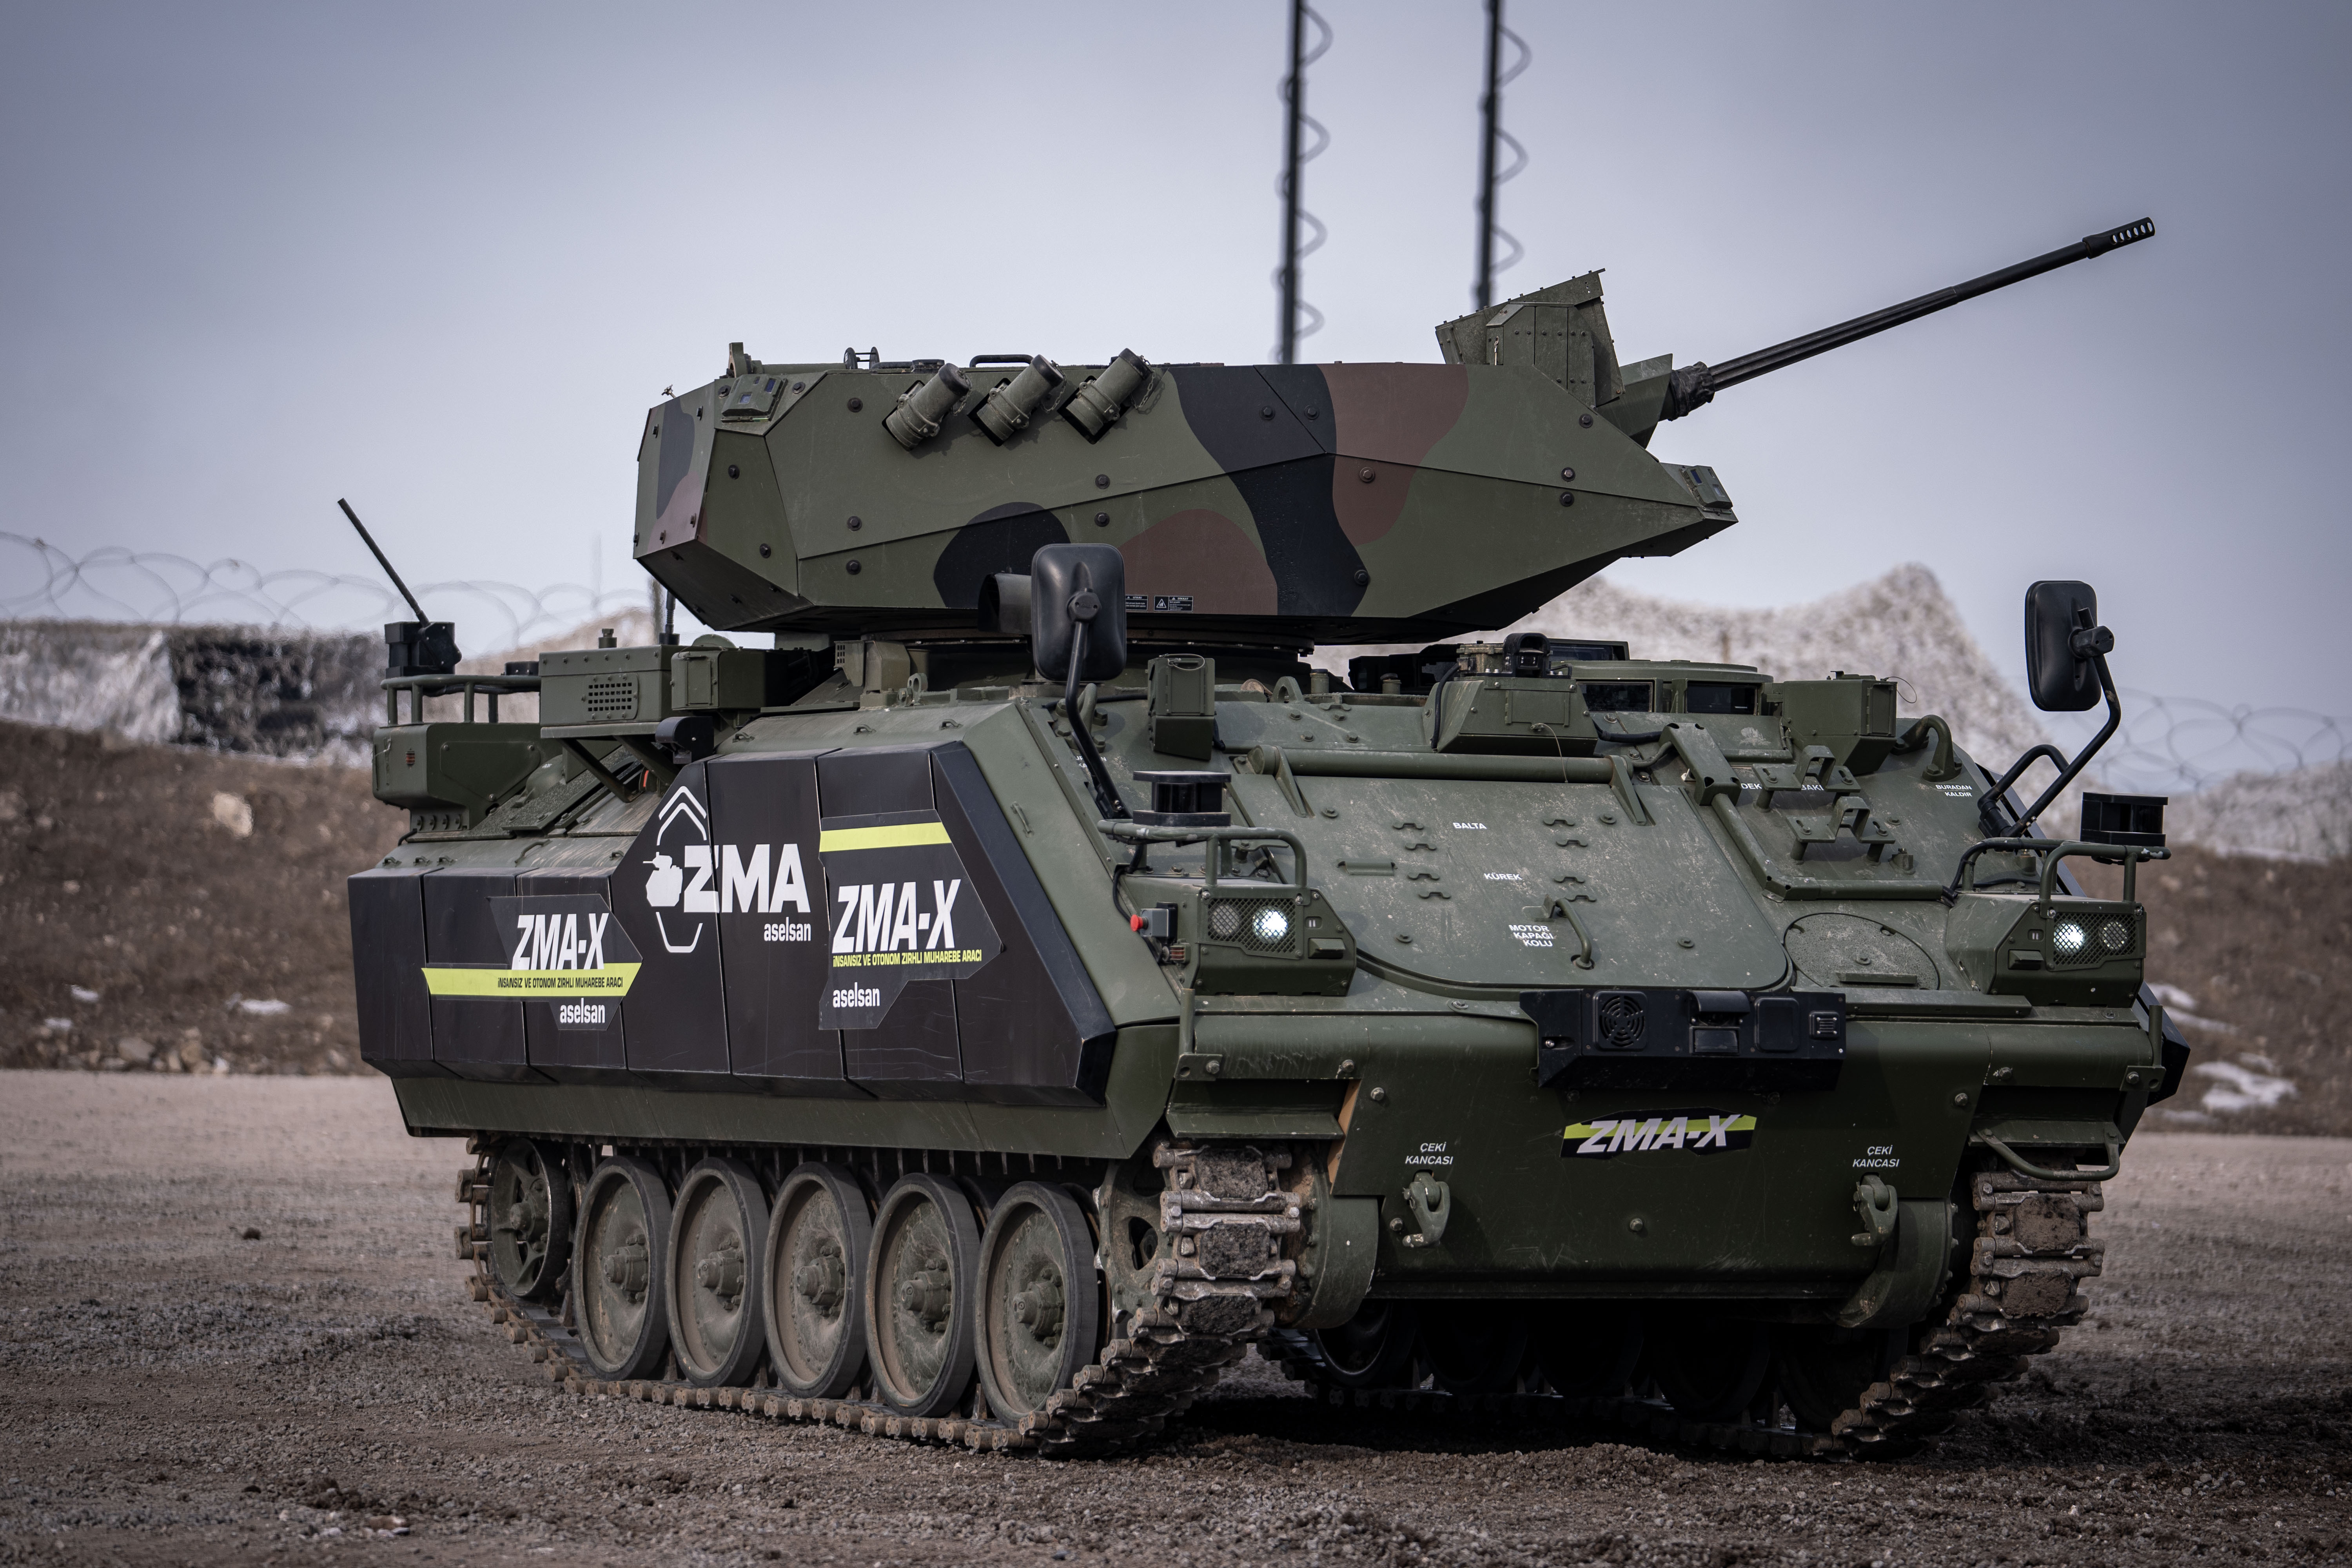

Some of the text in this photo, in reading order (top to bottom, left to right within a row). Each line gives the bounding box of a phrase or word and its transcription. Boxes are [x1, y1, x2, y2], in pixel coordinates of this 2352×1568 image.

[684, 844, 811, 913] ZMA
[764, 916, 811, 941] aselsan
[832, 879, 961, 953] ZMA-X
[512, 913, 609, 970] ZMA-X
[863, 954, 871, 966] VE
[872, 953, 900, 965] OTONOM
[902, 952, 922, 964] ZIRHLI
[924, 950, 960, 963] MUHAREBE
[962, 949, 982, 962] ARACI
[524, 978, 531, 988] VE
[533, 978, 556, 988] OTONOM
[557, 978, 573, 988] ZIRHLI
[575, 977, 604, 988] MUHAREBE
[606, 977, 623, 987] ARACI
[833, 982, 880, 1007] aselsan
[560, 998, 605, 1023] aselsan
[1576, 1114, 1741, 1154] ZMA-X
[1420, 1142, 1446, 1152] ÇEKİ
[1867, 1145, 1893, 1156] ÇEKİ
[1405, 1156, 1453, 1164] KANCASI
[1853, 1159, 1900, 1167] KANCASI
